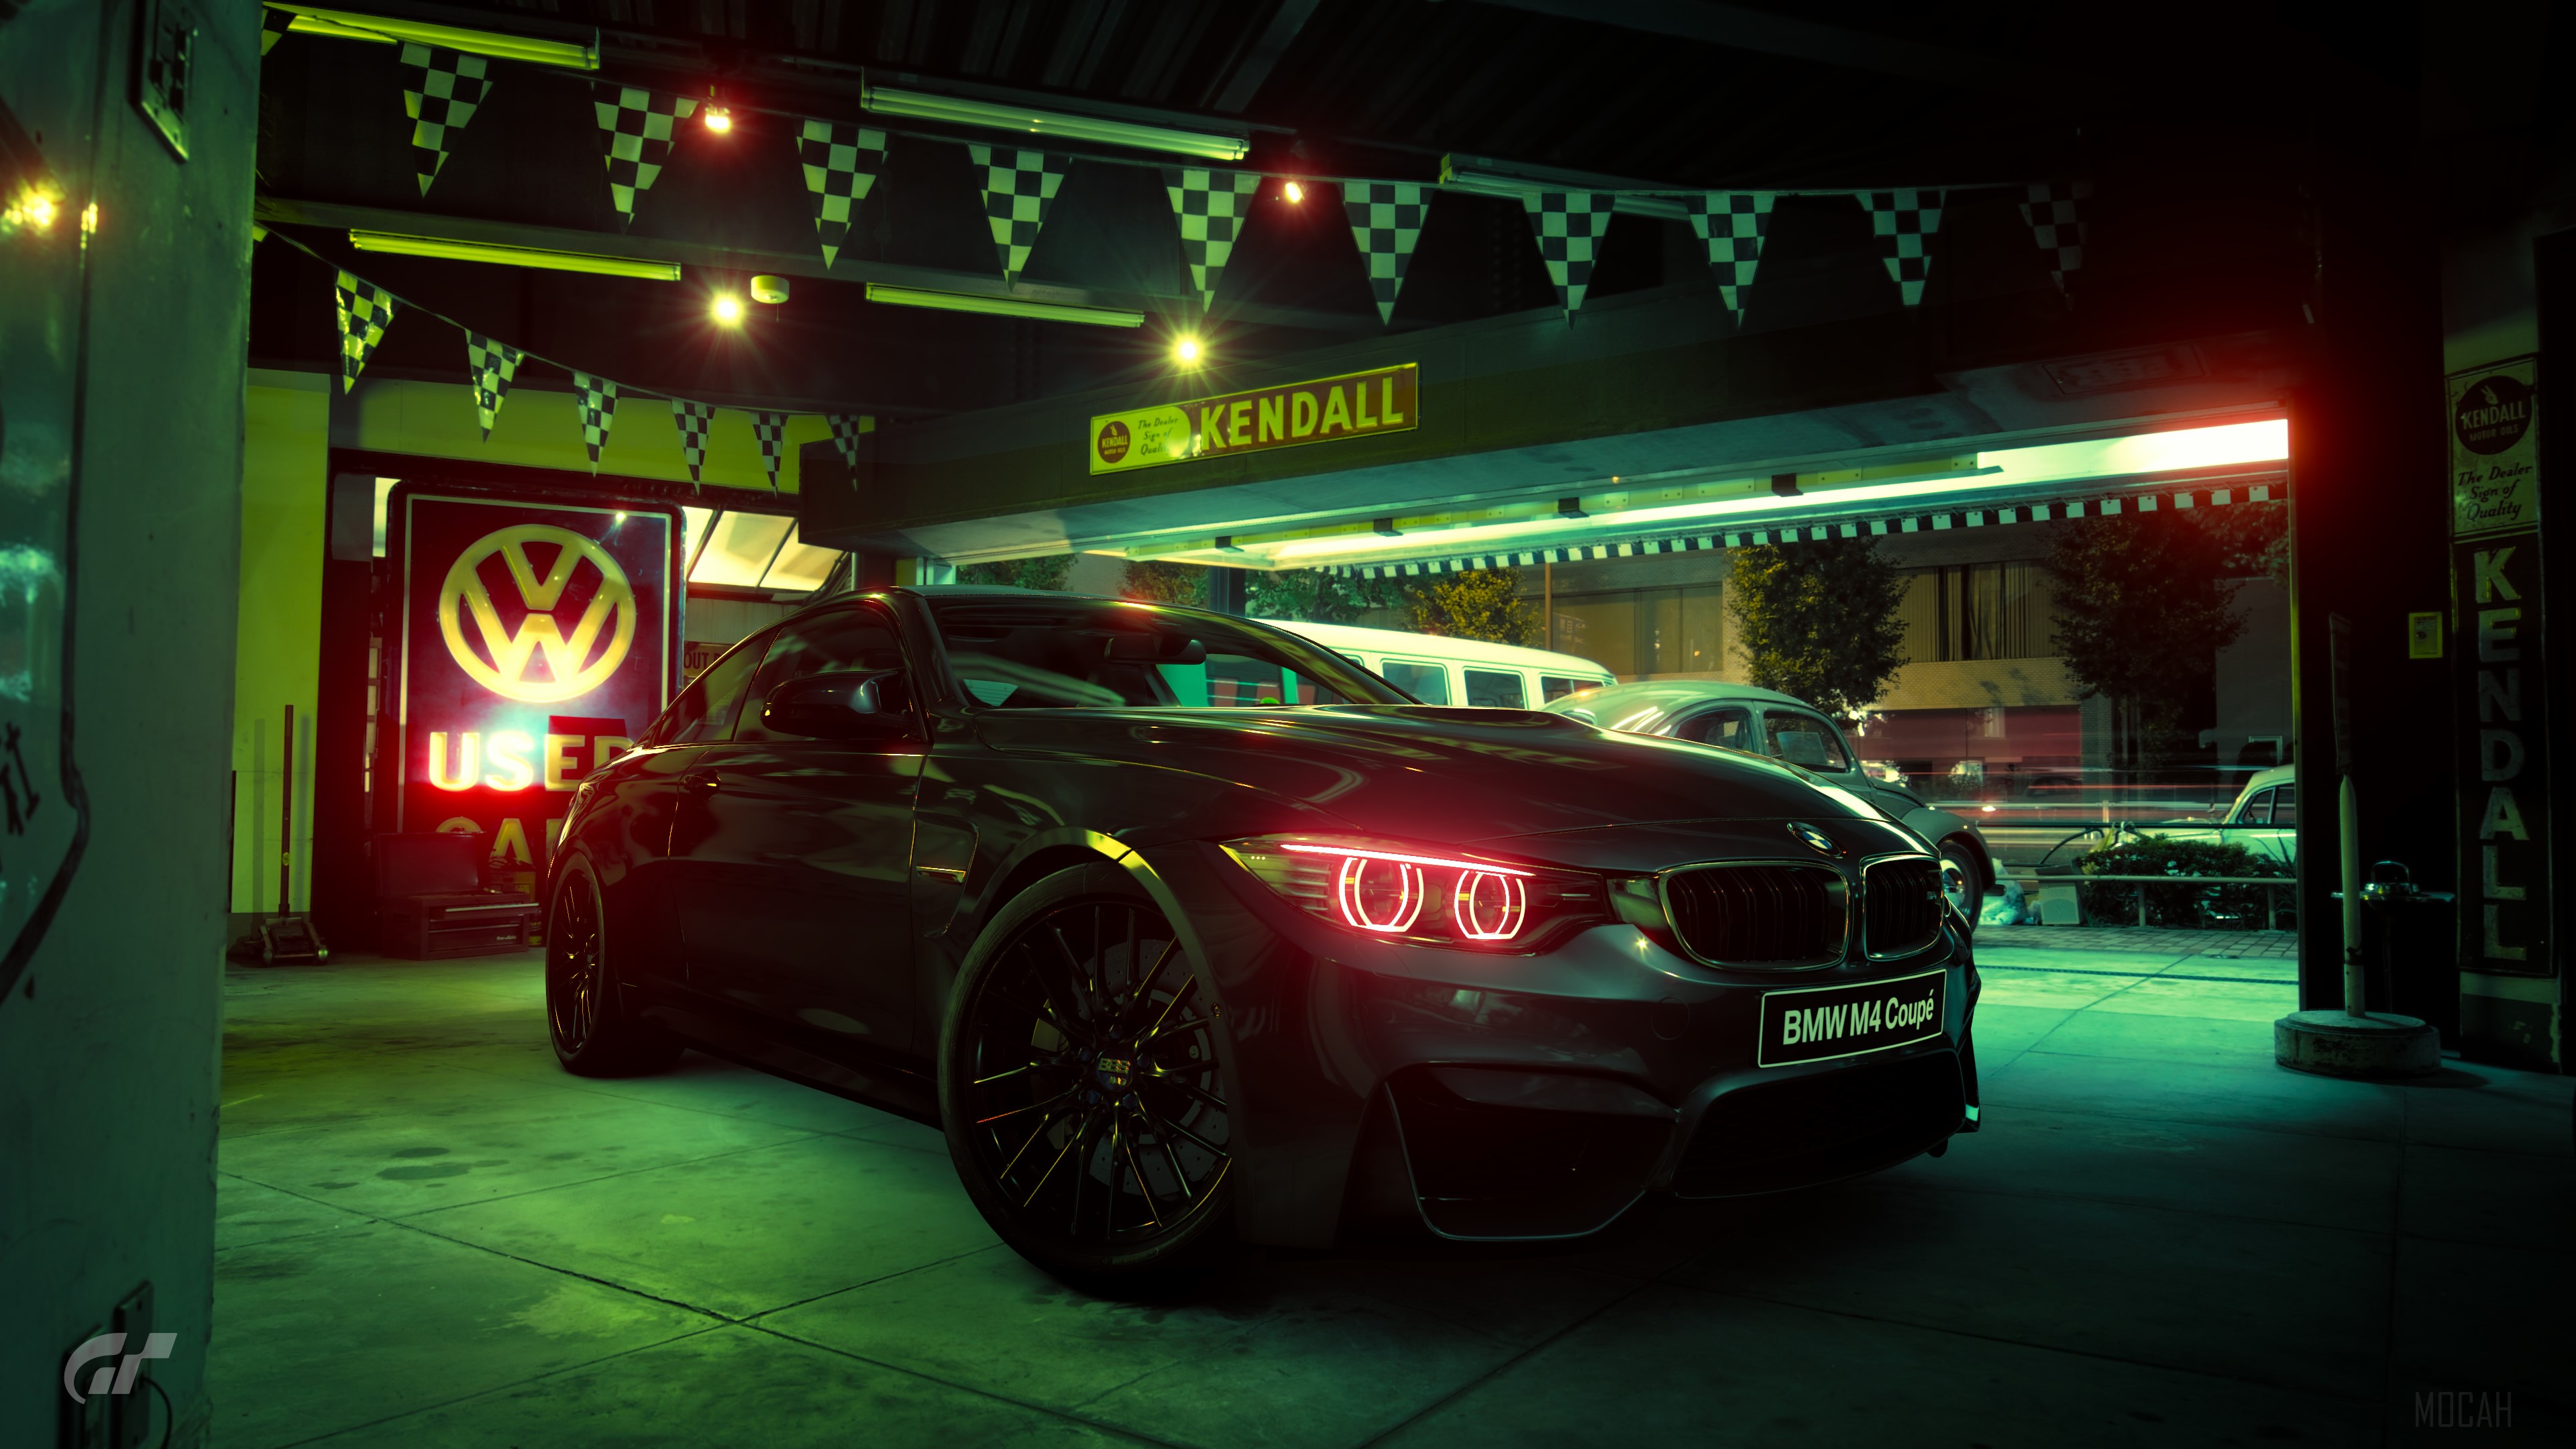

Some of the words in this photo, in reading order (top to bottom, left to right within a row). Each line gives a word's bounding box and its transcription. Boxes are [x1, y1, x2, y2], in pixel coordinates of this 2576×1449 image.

[1138, 419, 1151, 429] The
[1154, 416, 1179, 427] Dealer
[1201, 376, 1403, 451] KENDALL
[2461, 400, 2526, 430] KENDALL
[1102, 435, 1128, 449] KENDALL
[1143, 431, 1160, 442] Sign
[2469, 428, 2497, 441] MOTOR
[2500, 423, 2519, 436] OILS
[1140, 442, 1169, 456] Quali
[2458, 471, 2483, 486] The
[2489, 462, 2532, 480] Dealer
[2470, 486, 2498, 502] Sign
[2503, 478, 2520, 499] of
[2467, 500, 2522, 521] Quality
[2473, 545, 2530, 961] KENDALL
[1782, 1004, 1848, 1045] BMW
[1849, 1000, 1882, 1036] M4
[1885, 988, 1934, 1030] Coupé
[1097, 1057, 1131, 1075] BBS
